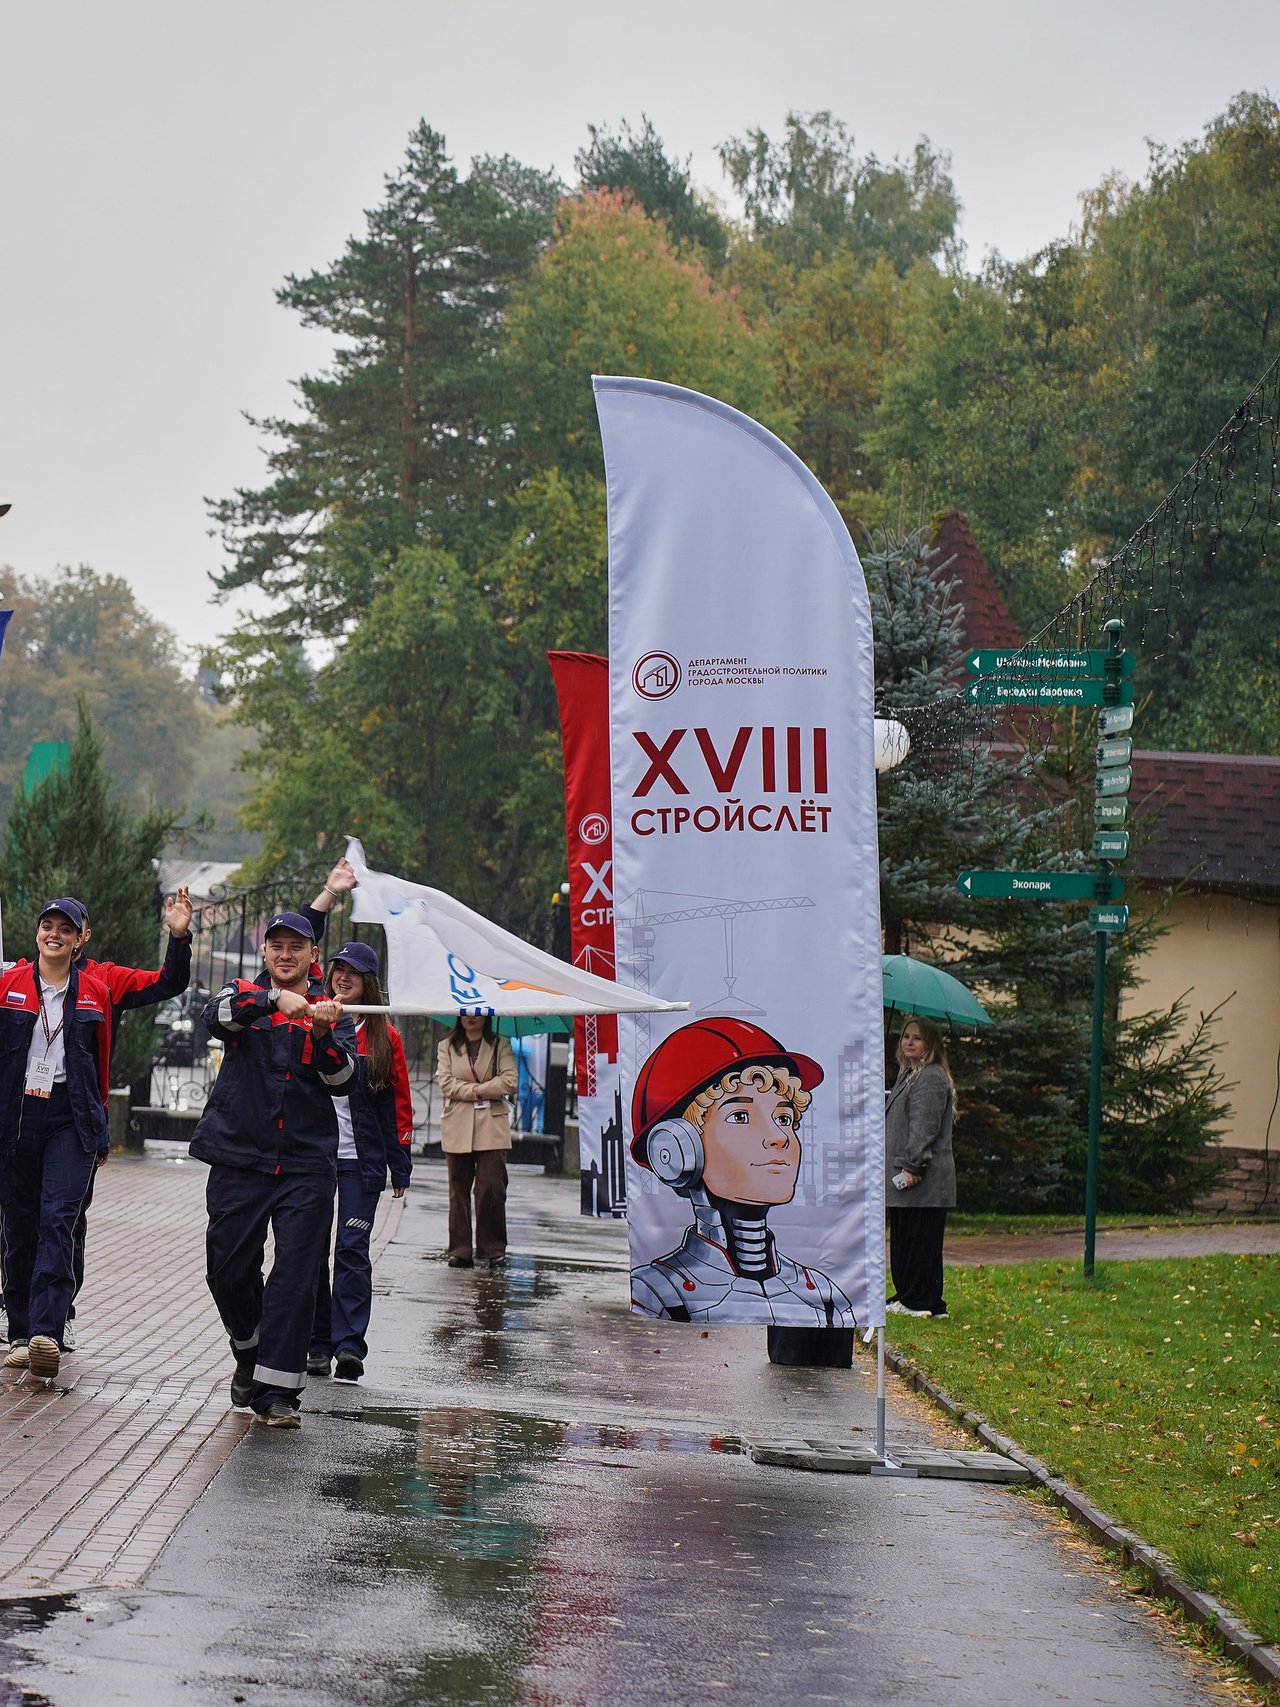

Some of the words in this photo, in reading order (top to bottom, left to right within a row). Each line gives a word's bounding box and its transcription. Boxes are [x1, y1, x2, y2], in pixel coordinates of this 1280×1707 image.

[688, 658, 748, 667] ДЕПАРТАМЕНТ
[688, 666, 781, 677] ГРАДОСТРОИТЕЛЬНОЙ
[783, 668, 828, 676] ПОЛИТИКИ
[688, 678, 724, 686] ГОРОДА
[726, 677, 765, 685] МОСКВЫ
[996, 686, 1038, 699] Беседки
[1039, 685, 1083, 699] барбекю
[631, 726, 829, 798] XVIII
[631, 798, 832, 836] СТРОЙСЛЁТ
[1012, 879, 1051, 891] Экопарк
